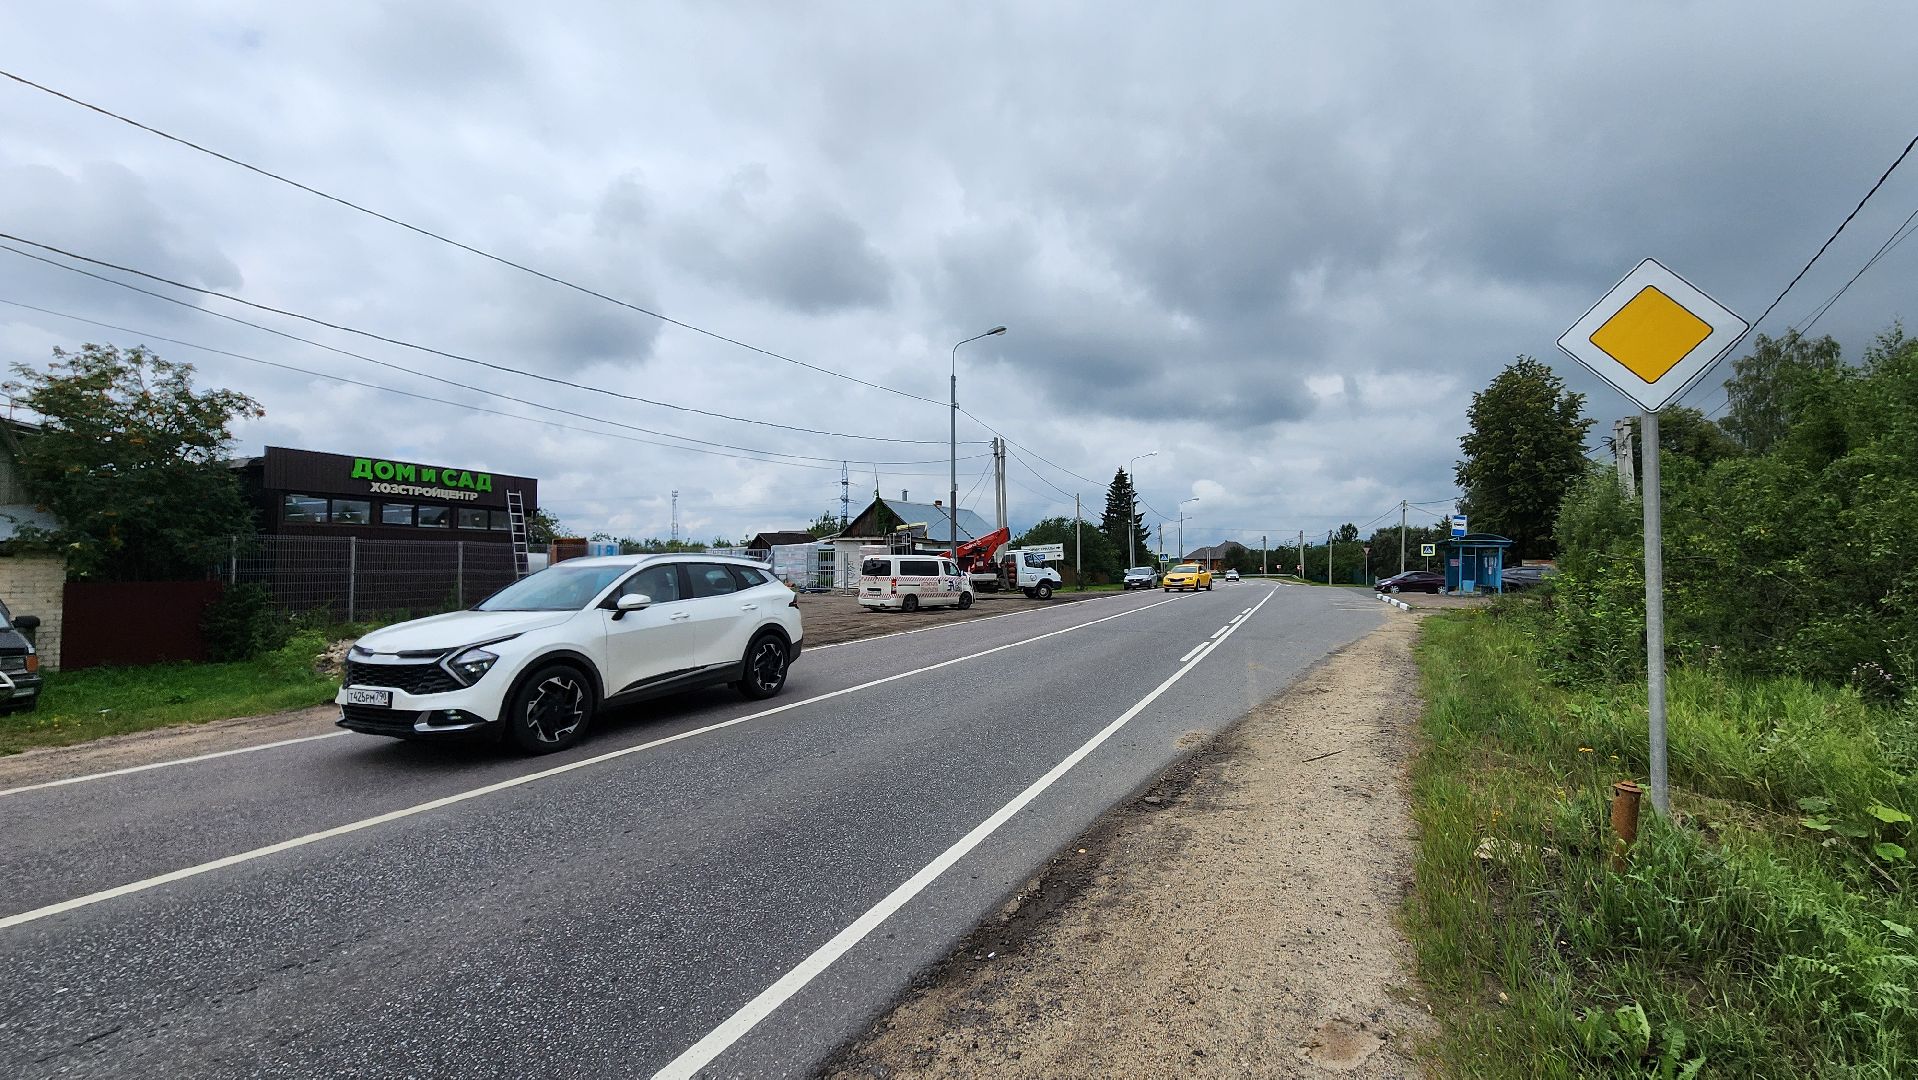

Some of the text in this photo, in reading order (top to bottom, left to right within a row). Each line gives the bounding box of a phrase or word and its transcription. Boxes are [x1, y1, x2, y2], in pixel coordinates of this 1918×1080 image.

[351, 458, 416, 482] ДОМ
[441, 469, 492, 492] САД
[370, 481, 479, 501] ХОЗСТРОЙЦЕНТР
